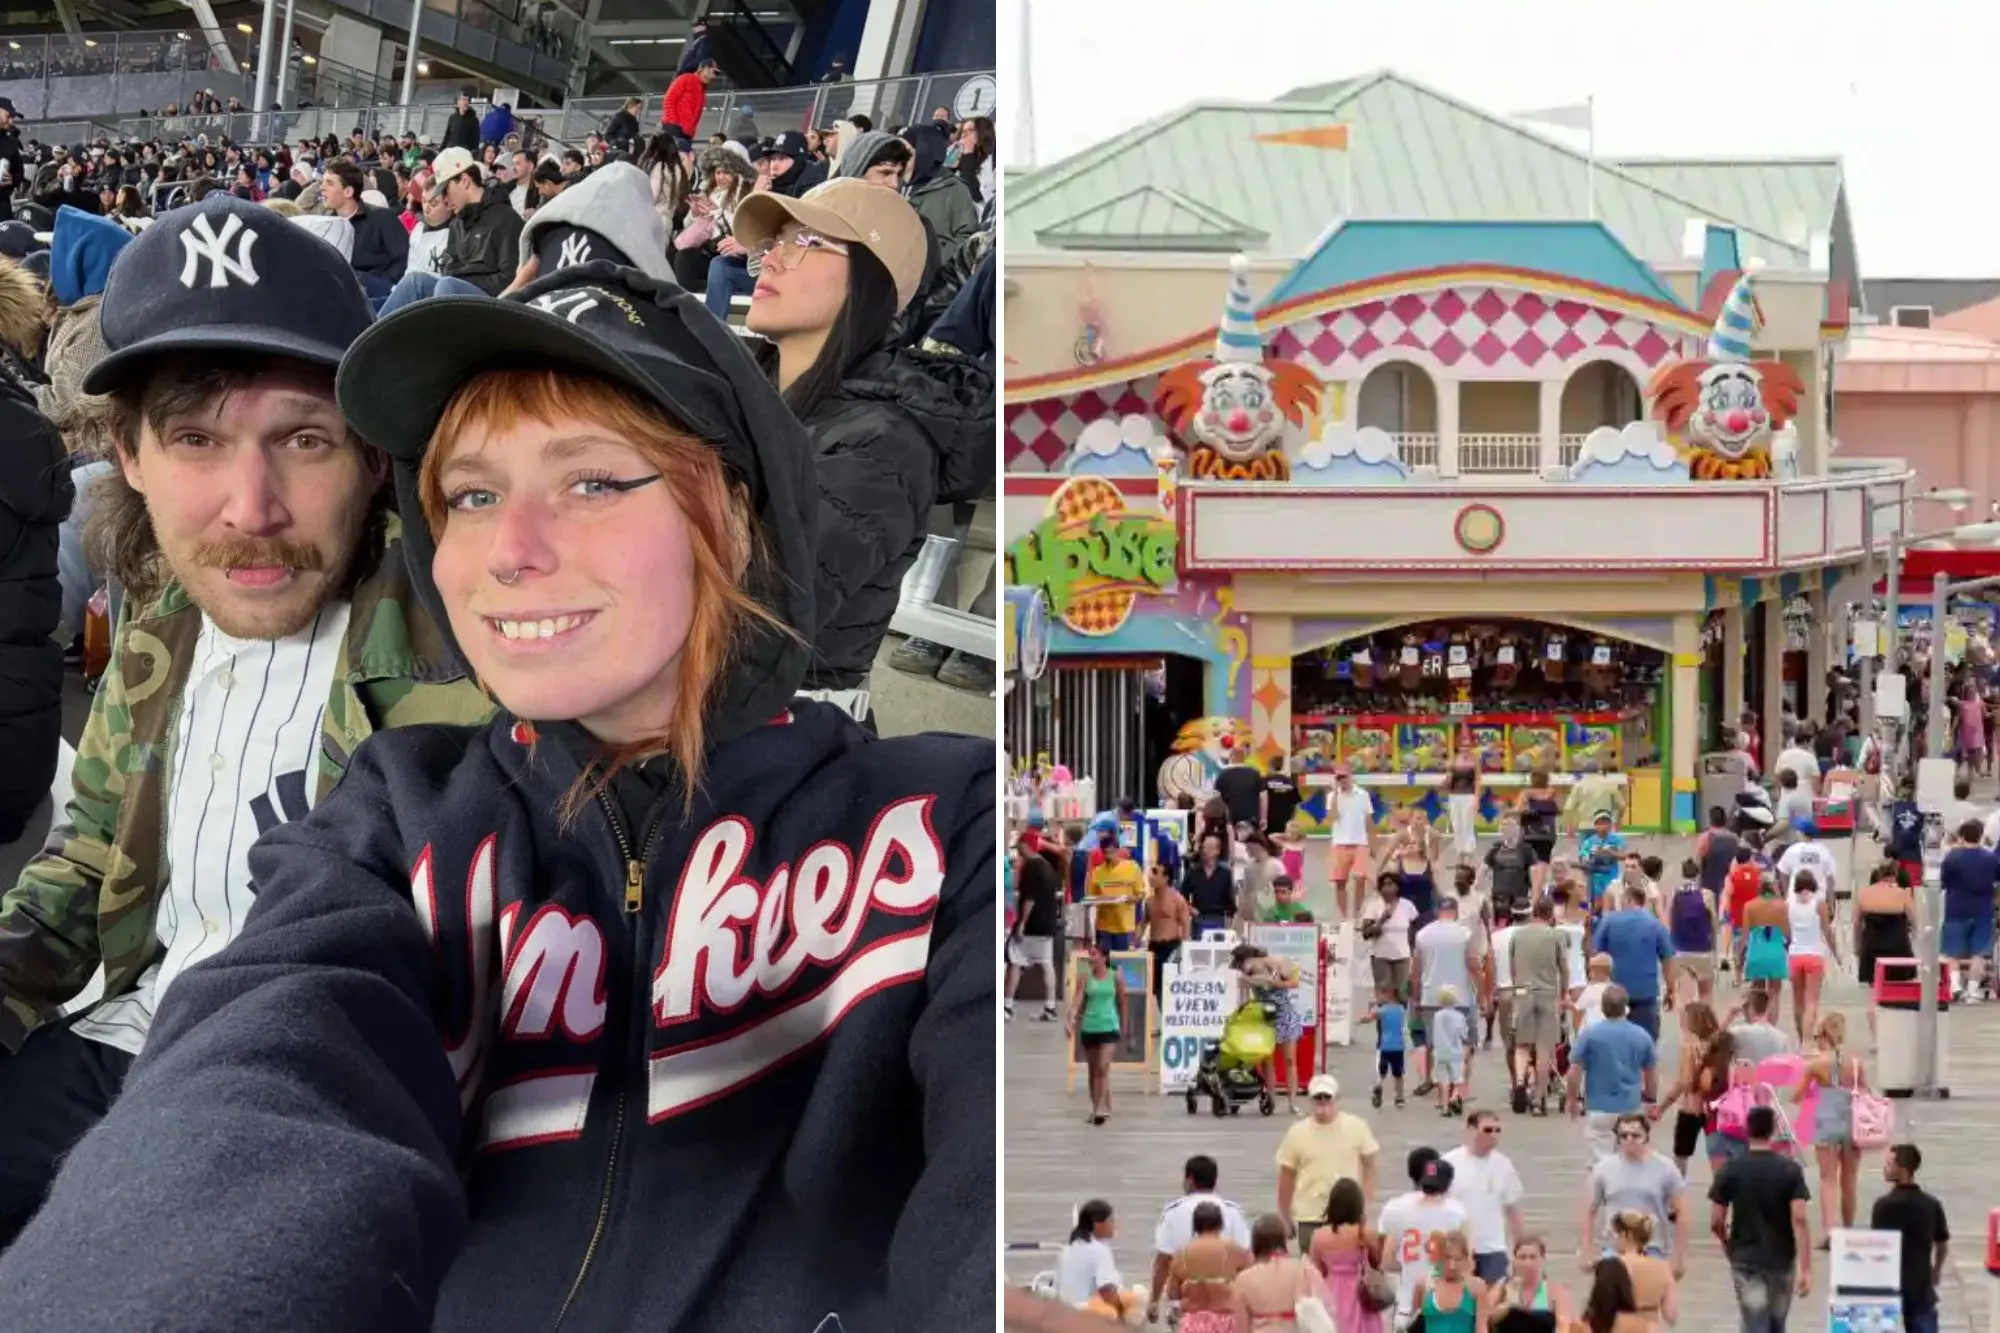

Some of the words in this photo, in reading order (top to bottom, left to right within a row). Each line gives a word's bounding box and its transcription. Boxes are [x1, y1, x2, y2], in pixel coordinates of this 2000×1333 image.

[970, 87, 982, 111] 1
[179, 212, 260, 289] NY
[556, 231, 592, 270] NY
[410, 793, 945, 1113] Ynkees
[1170, 980, 1226, 995] OCEAN
[1175, 998, 1220, 1012] VIEW
[1163, 1036, 1220, 1069] OPE
